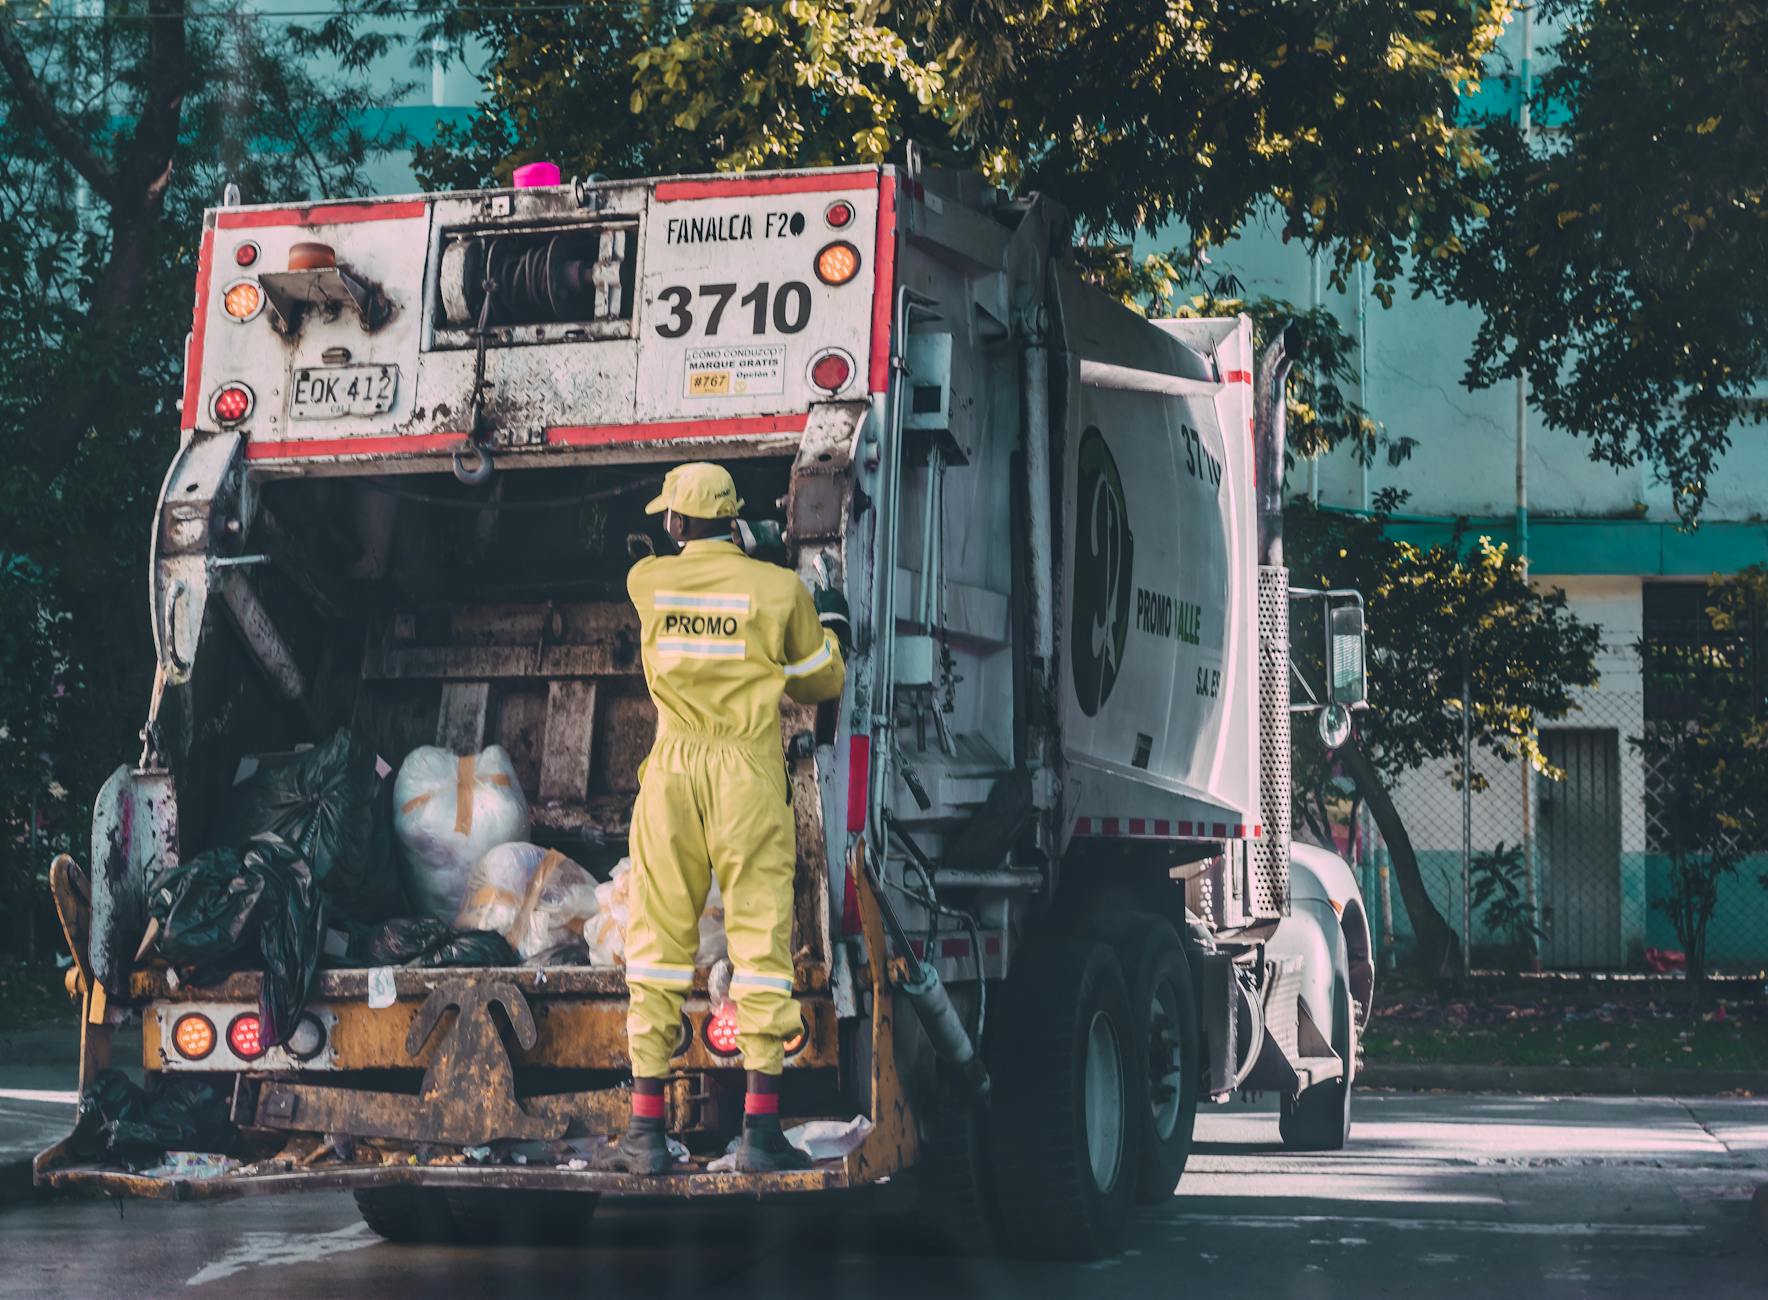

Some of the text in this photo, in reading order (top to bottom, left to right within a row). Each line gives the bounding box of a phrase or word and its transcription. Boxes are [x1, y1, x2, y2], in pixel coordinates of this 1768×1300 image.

[668, 214, 752, 244] FANALCA
[655, 281, 812, 338] 3710
[689, 358, 778, 370] MARQUE GRATIS
[295, 375, 391, 404] EOK 412
[694, 374, 726, 388] #767
[665, 615, 737, 636] PROMO
